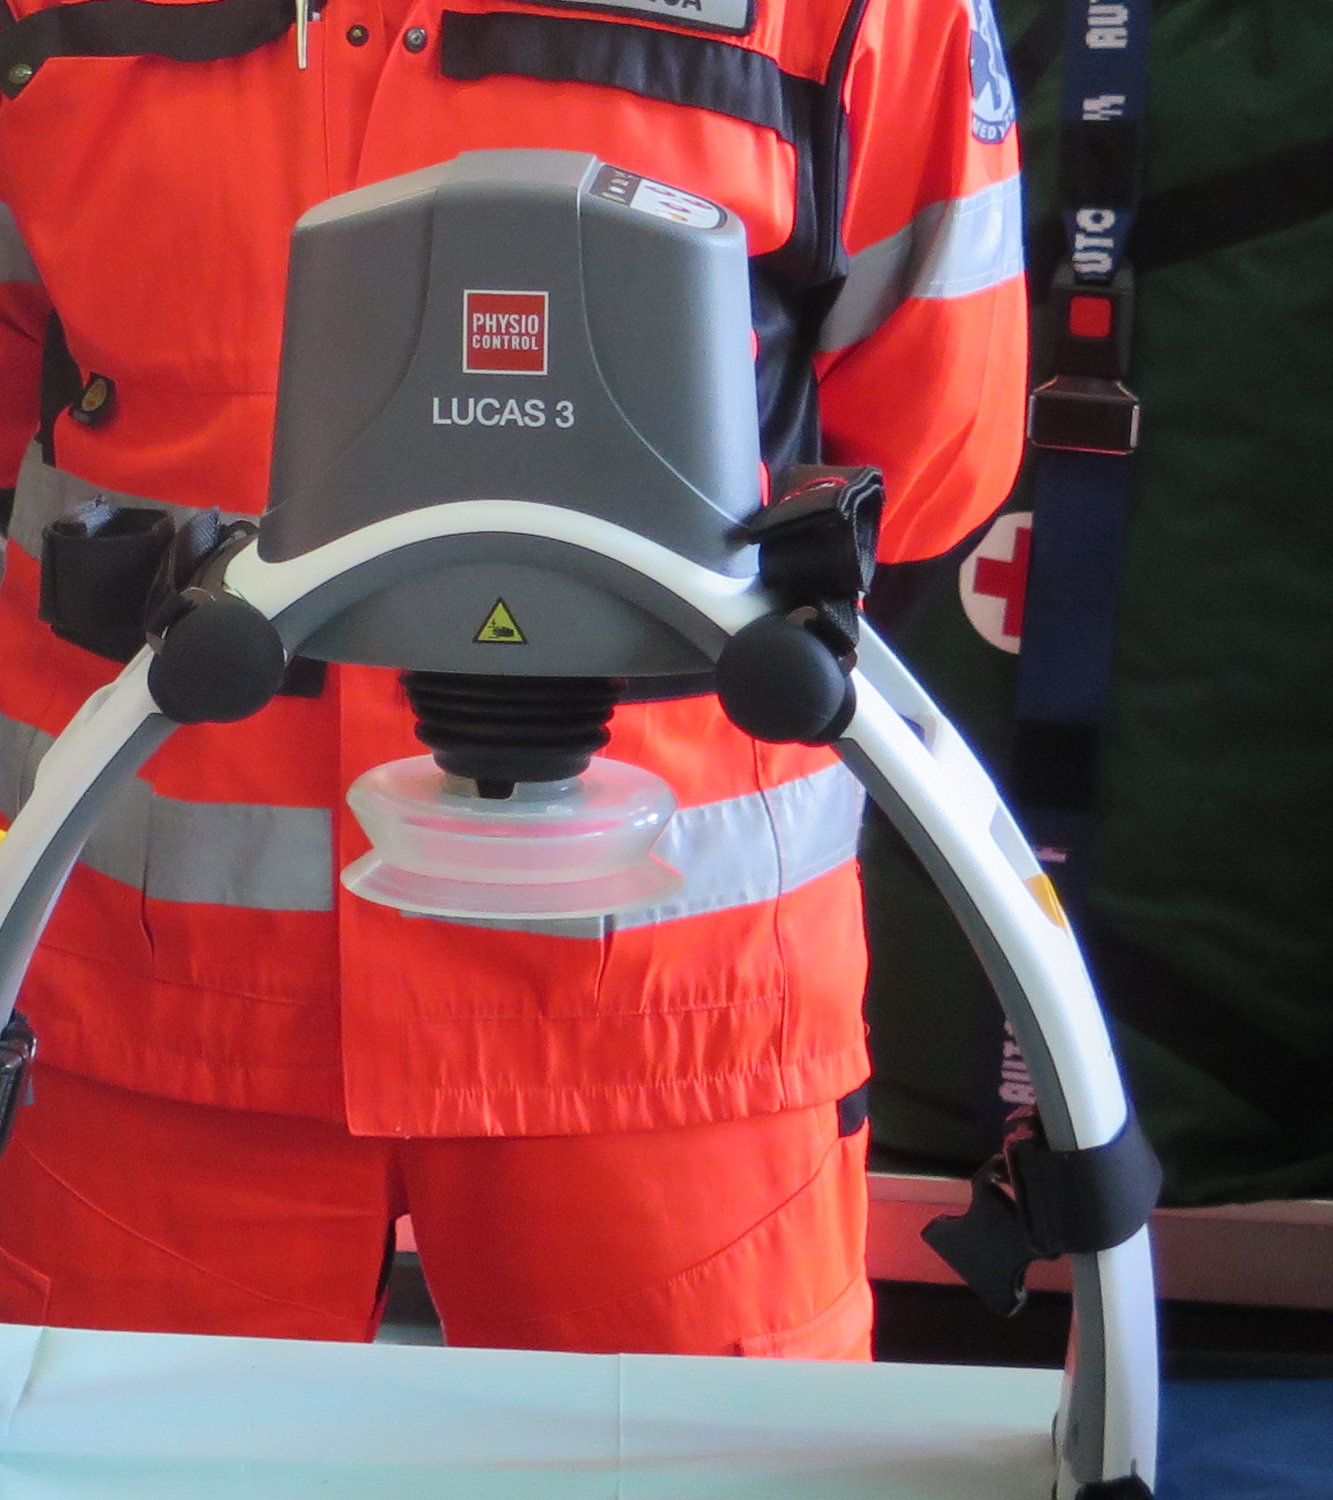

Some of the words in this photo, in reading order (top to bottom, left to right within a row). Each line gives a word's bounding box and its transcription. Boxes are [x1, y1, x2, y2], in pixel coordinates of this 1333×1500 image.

[472, 313, 539, 334] PHYSIO
[472, 334, 539, 351] CONTROL
[432, 397, 547, 427] LUCAS
[555, 400, 575, 429] 3
